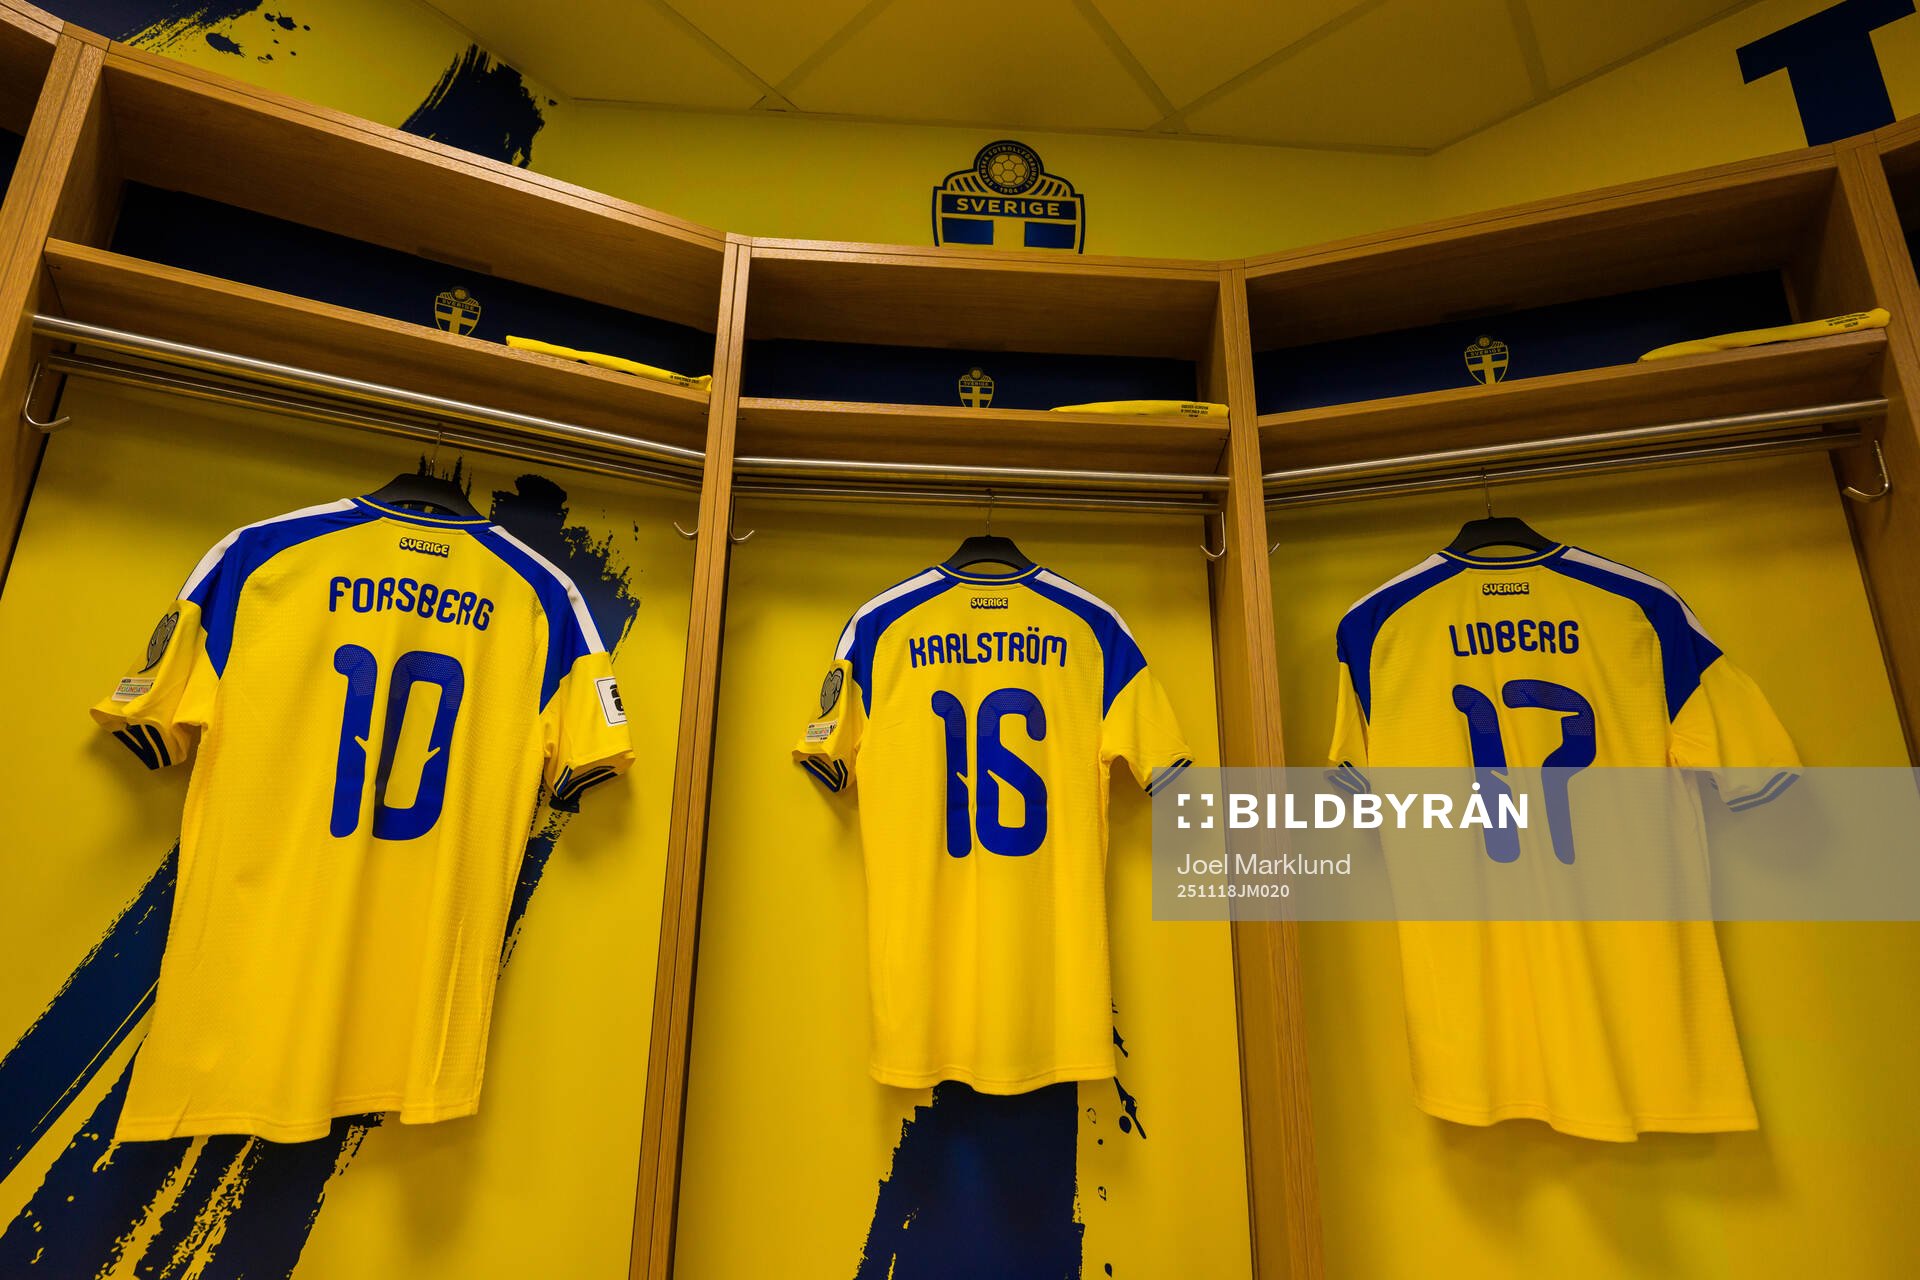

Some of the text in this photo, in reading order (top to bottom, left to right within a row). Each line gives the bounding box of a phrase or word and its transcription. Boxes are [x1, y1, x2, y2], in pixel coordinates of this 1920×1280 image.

[956, 198, 1060, 217] SVERIGE
[400, 537, 449, 558] SVERIGE
[329, 576, 494, 631] FORSBERG
[970, 597, 1008, 609] SVERIGE
[1482, 582, 1530, 596] SVERIGE
[909, 626, 1068, 668] KARLSTRÖM
[1449, 619, 1579, 657] LIDBERG
[330, 644, 465, 840] 10
[931, 687, 1048, 858] 16
[1452, 679, 1597, 865] 17
